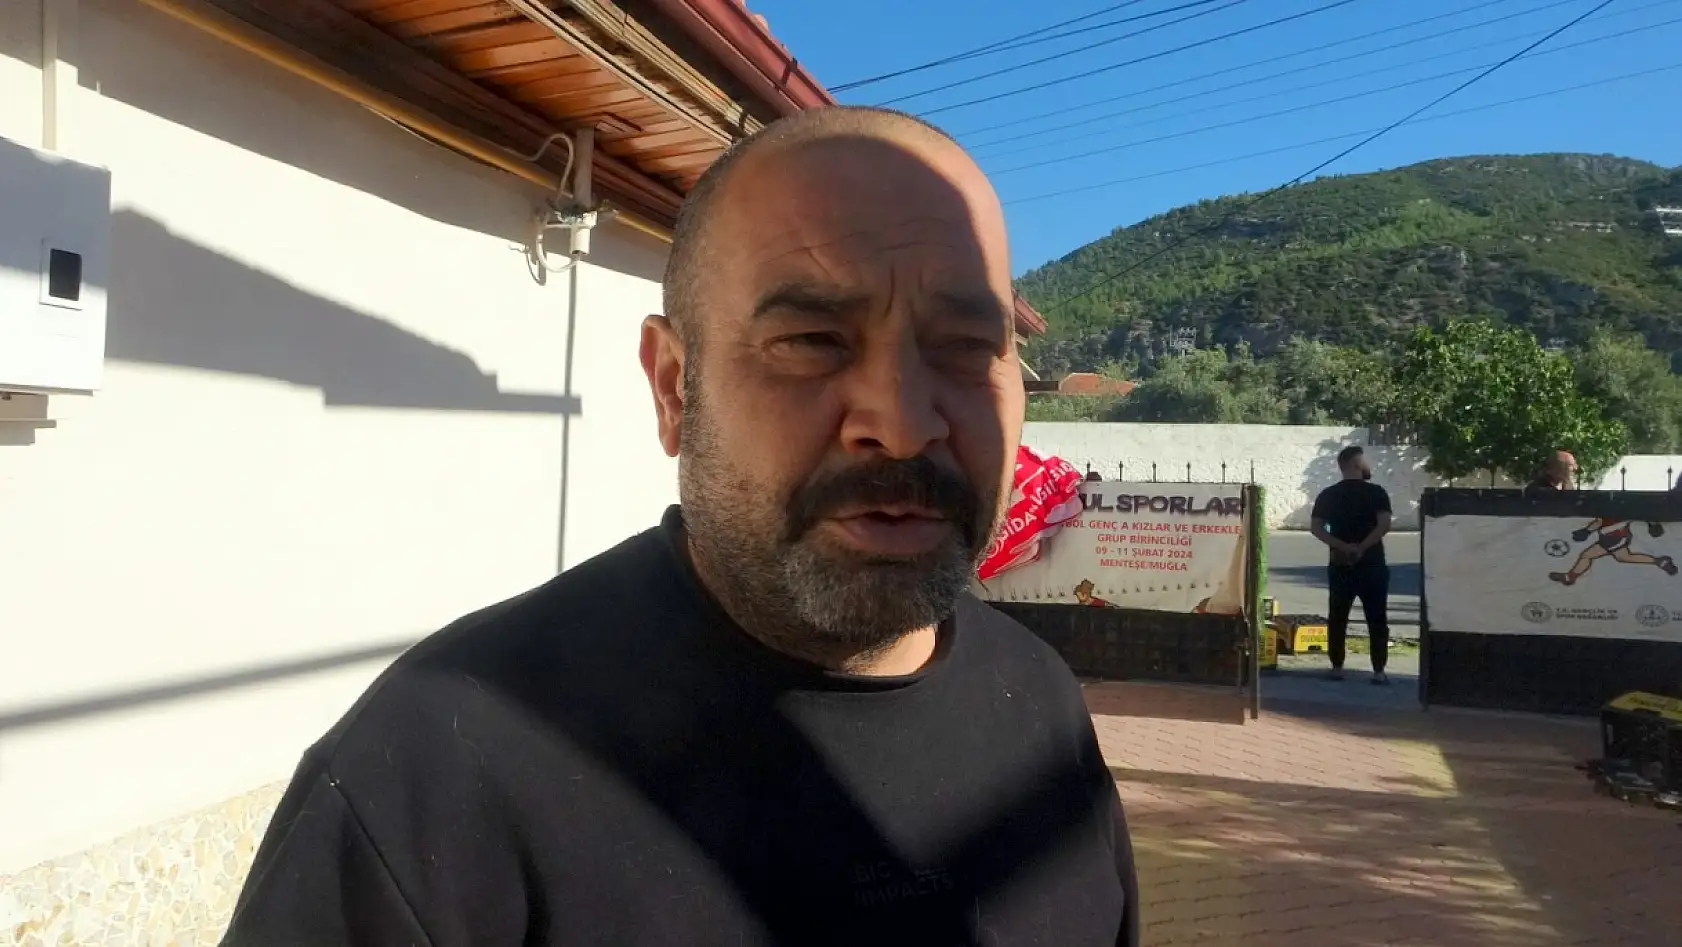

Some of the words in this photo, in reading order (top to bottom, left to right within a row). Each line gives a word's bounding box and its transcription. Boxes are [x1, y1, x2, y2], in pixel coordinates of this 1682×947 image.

[1061, 519, 1085, 528] BOL
[1089, 521, 1117, 532] GENÇ
[1121, 522, 1129, 531] A
[1132, 522, 1170, 532] KIZLAR
[1174, 524, 1188, 532] VE
[1097, 533, 1127, 544] GRUP
[1095, 546, 1108, 555] 09
[1117, 547, 1128, 556] 11
[1132, 547, 1164, 558] ŞUBAT
[1167, 549, 1193, 559] 2024
